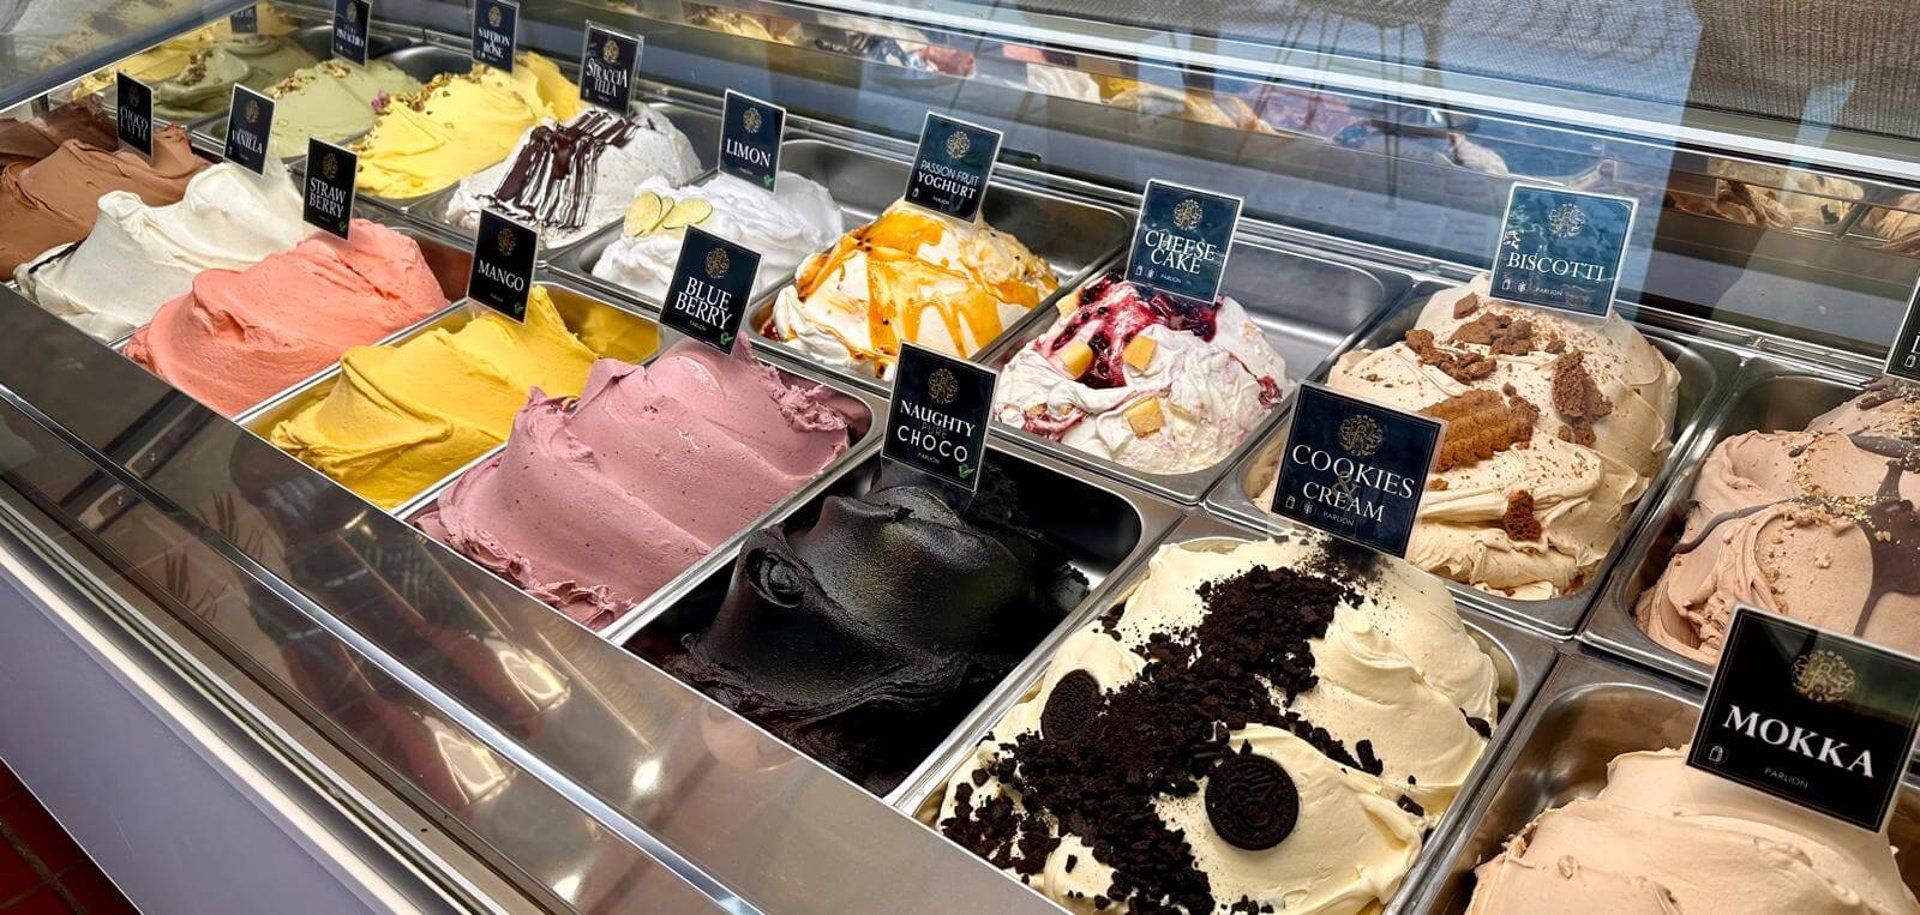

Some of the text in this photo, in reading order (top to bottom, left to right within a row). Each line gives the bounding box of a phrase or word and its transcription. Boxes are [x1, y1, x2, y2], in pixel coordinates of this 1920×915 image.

[483, 41, 504, 58] ROSE
[586, 57, 627, 88] STRACCIA
[595, 79, 616, 97] TELLA
[232, 129, 263, 154] VANILLA
[726, 138, 771, 168] LIMON
[918, 170, 976, 199] YOGHURT
[920, 159, 979, 187] PASSION FRUIT
[309, 176, 346, 204] STRAW
[309, 191, 344, 218] BERRY
[1145, 229, 1217, 261] CHEESE
[478, 259, 524, 291] MANGO
[1151, 247, 1202, 275] CAKE
[1507, 252, 1605, 283] BISCOTTI
[685, 276, 732, 312] BLUE
[1535, 287, 1563, 297] PARLION
[674, 291, 733, 330] BERRY
[900, 399, 976, 437] NAUGHTY
[921, 421, 948, 440] PURE
[897, 425, 968, 463] CHOCO
[1292, 444, 1415, 499] COOKIES
[1302, 481, 1385, 523] CREAM
[1322, 510, 1354, 527] PARLION
[1722, 703, 1874, 779] MOKKA
[1764, 766, 1809, 789] PARLION
